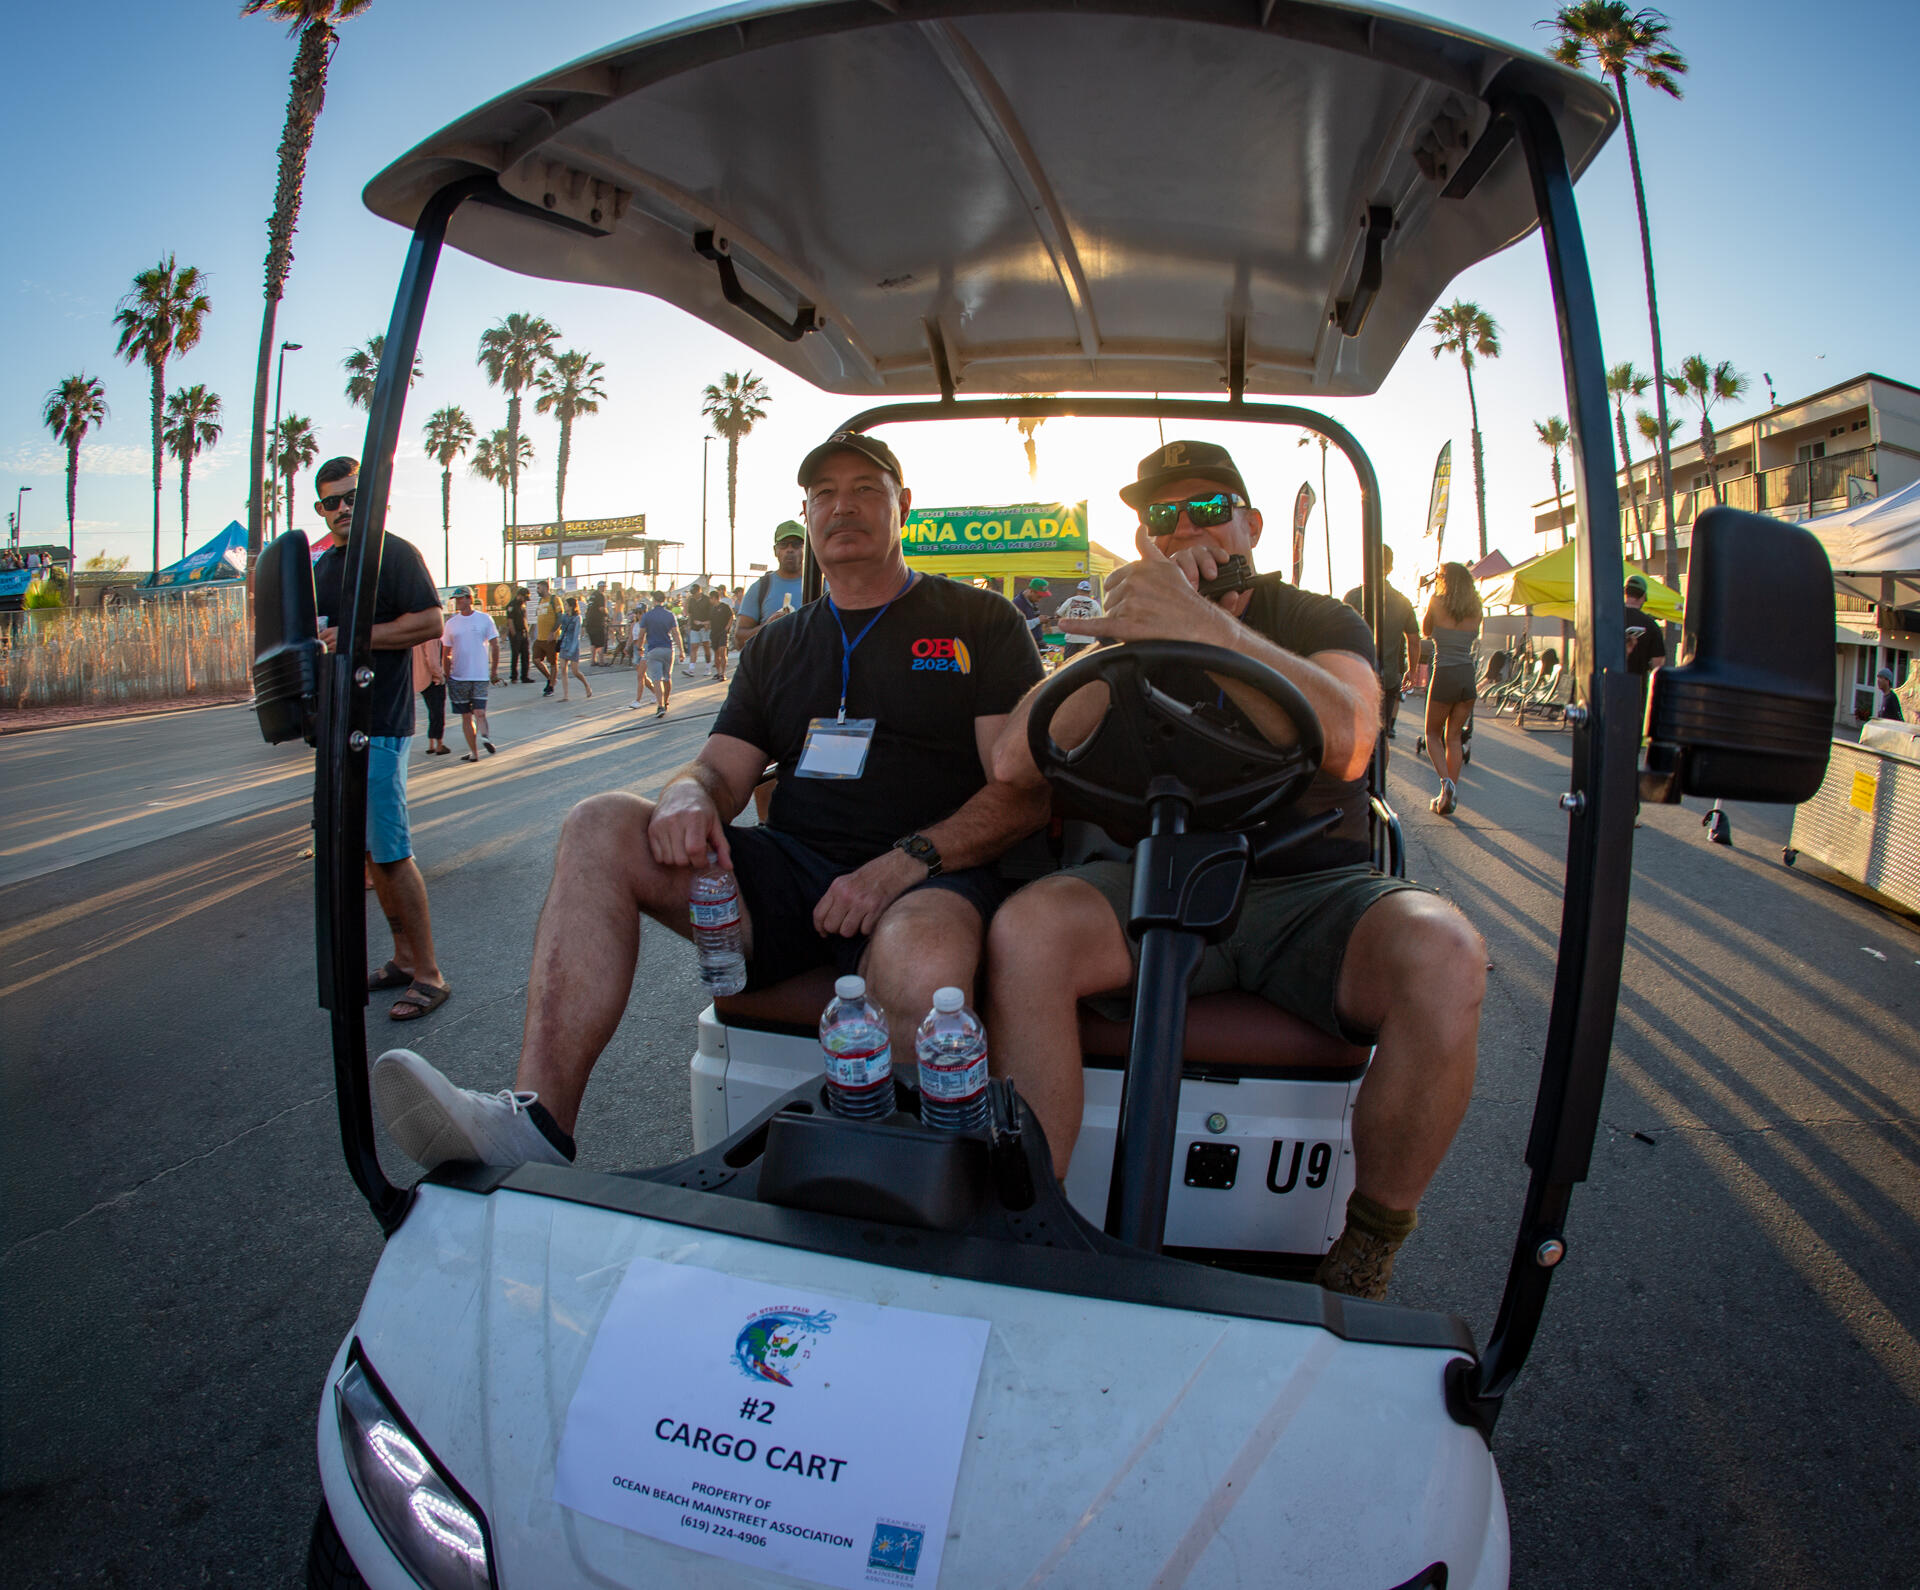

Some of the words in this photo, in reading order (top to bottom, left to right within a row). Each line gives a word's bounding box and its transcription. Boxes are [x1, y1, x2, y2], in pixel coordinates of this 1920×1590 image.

[565, 521, 589, 531] BUZZ
[589, 516, 642, 530] CANNABIS
[946, 510, 975, 518] BEST
[977, 509, 993, 517] OF
[999, 507, 1020, 516] THE
[964, 517, 1081, 541] COLADA
[941, 543, 985, 551] TODAS
[987, 542, 1005, 550] LA
[1008, 540, 1057, 549] MEJOR!
[911, 638, 955, 658] OB
[911, 658, 962, 672] 2024
[1266, 1140, 1332, 1194] U9
[739, 1397, 776, 1424] #2
[655, 1418, 757, 1462] CARGO
[765, 1446, 848, 1483] CART
[691, 1481, 752, 1506] PROPERTY
[754, 1498, 772, 1510] OF
[612, 1475, 650, 1496] OCEAN
[652, 1488, 690, 1507] BEACH
[692, 1500, 768, 1528] MAINSTREET
[769, 1520, 854, 1548] ASSOCIATION
[680, 1514, 710, 1534] (619)
[711, 1524, 767, 1547] 224-4906
